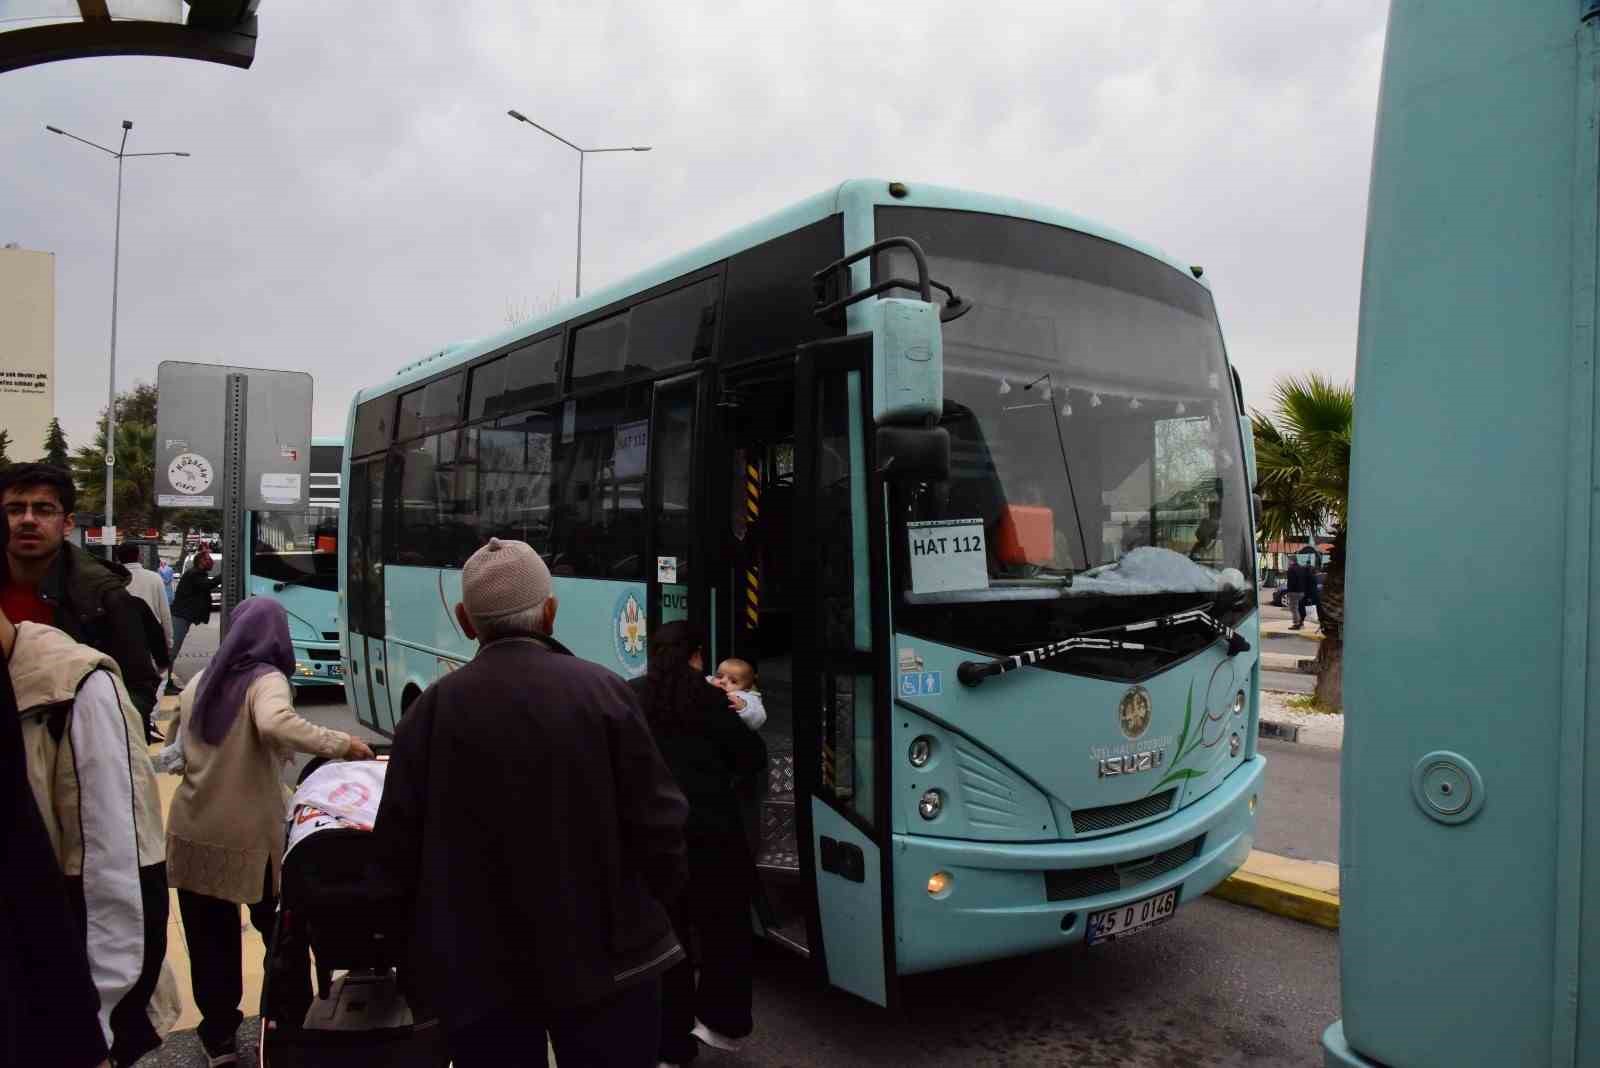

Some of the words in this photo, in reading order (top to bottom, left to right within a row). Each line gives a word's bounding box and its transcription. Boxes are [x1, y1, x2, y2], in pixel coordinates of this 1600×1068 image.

[913, 537, 948, 556] HAT
[952, 535, 982, 553] 112
[1098, 750, 1166, 778] ISUZU
[1095, 911, 1116, 934] 45
[1124, 907, 1134, 927] D
[1142, 893, 1174, 921] 0146
